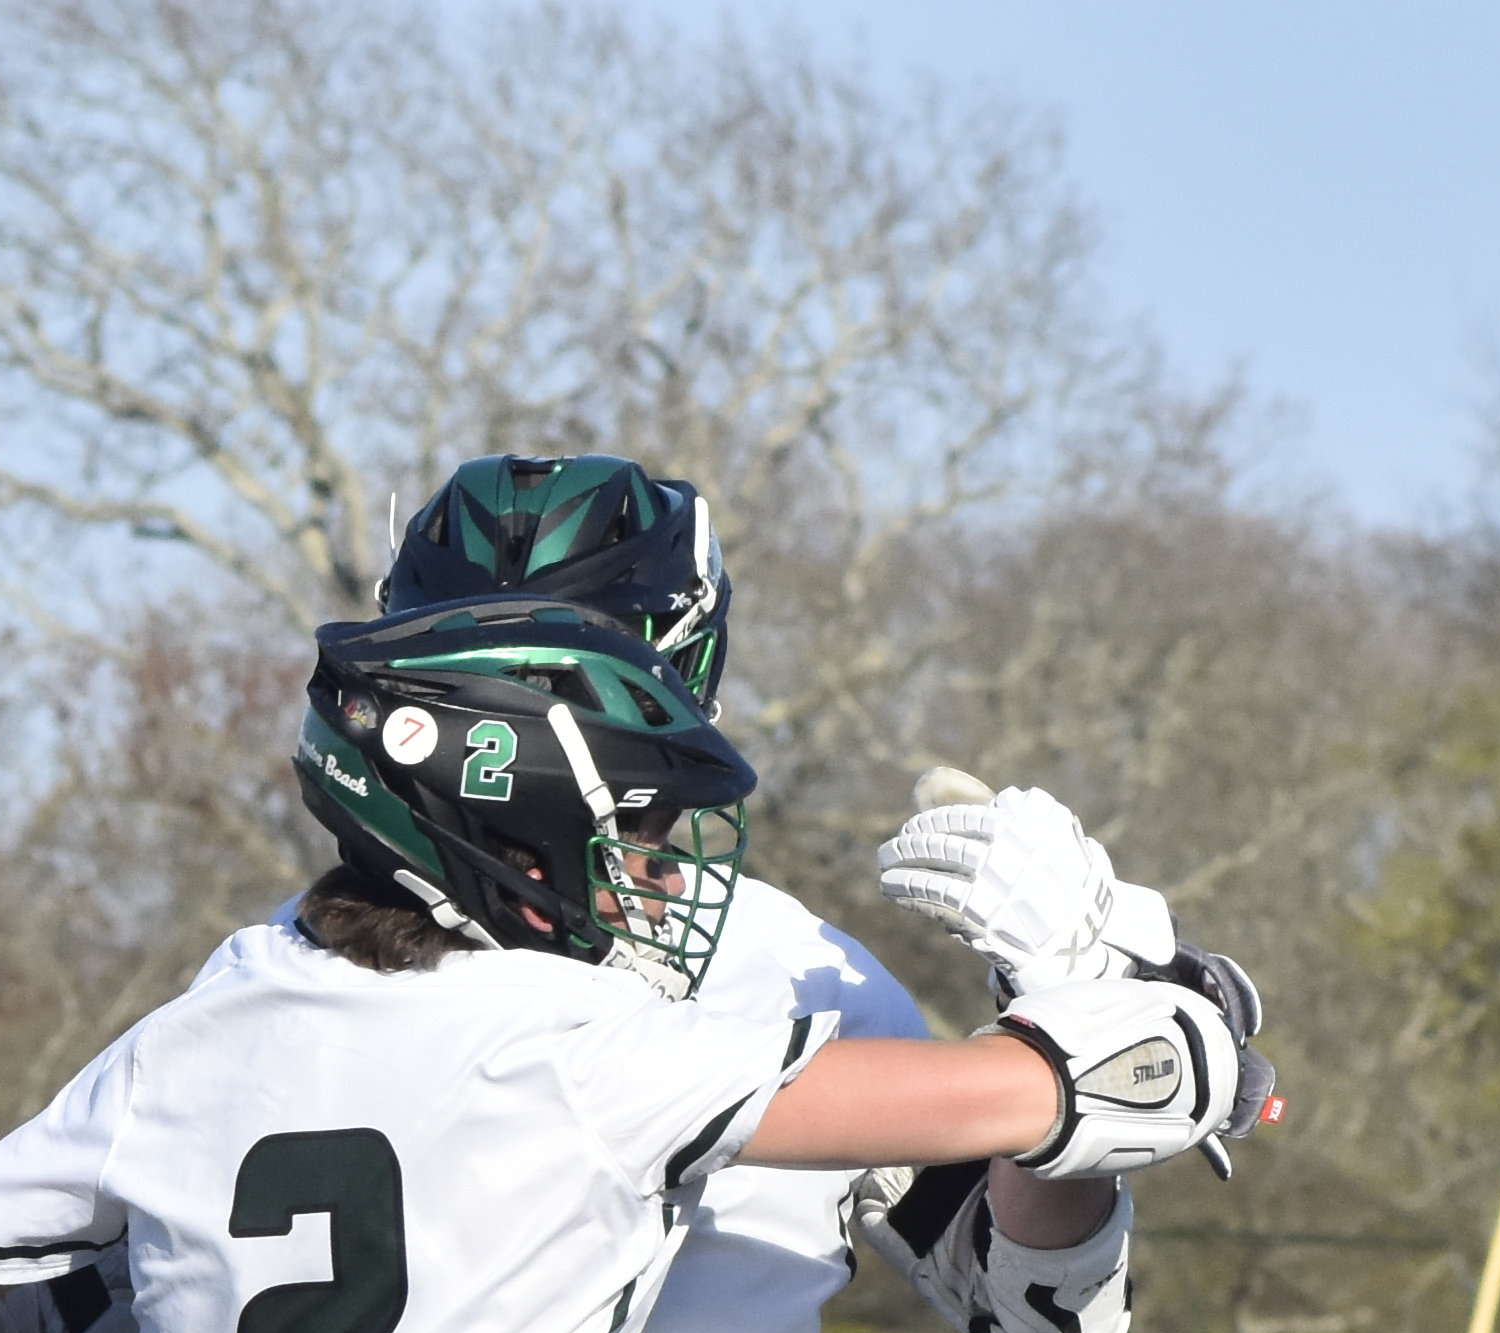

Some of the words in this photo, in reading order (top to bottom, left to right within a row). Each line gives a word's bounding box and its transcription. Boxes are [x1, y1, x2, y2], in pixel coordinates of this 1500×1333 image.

[324, 753, 369, 797] Beach
[460, 719, 518, 801] 2
[1052, 877, 1114, 977] STX
[1267, 1099, 1284, 1122] STX
